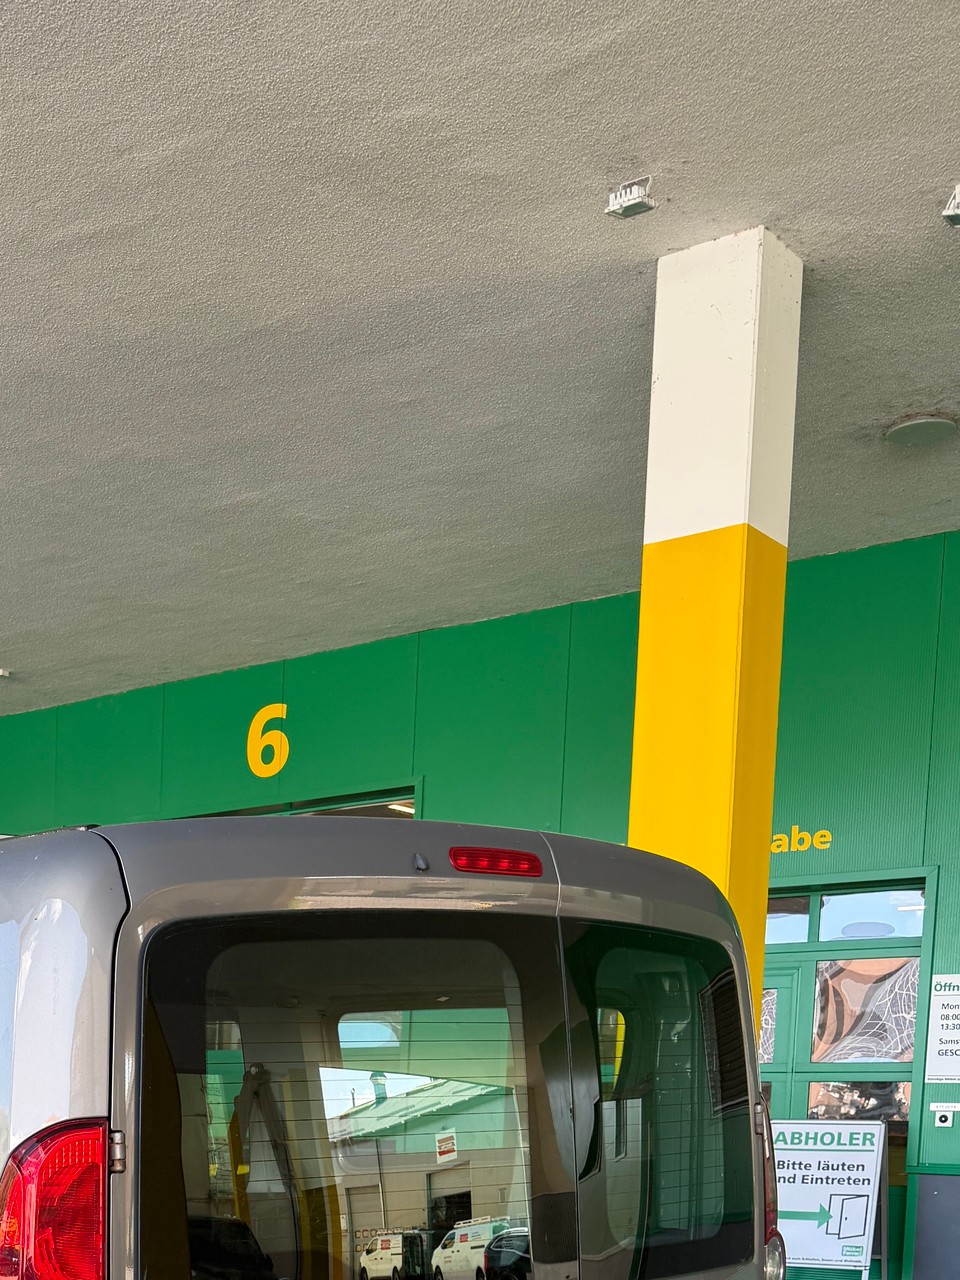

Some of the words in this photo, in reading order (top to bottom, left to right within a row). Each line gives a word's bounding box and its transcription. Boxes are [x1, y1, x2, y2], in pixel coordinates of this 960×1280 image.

[246, 703, 290, 779] 6
[774, 1131, 876, 1147] ABHOLER
[777, 1159, 812, 1171] Bitte
[817, 1160, 865, 1172] läuten
[801, 1173, 871, 1187] Eintreten
